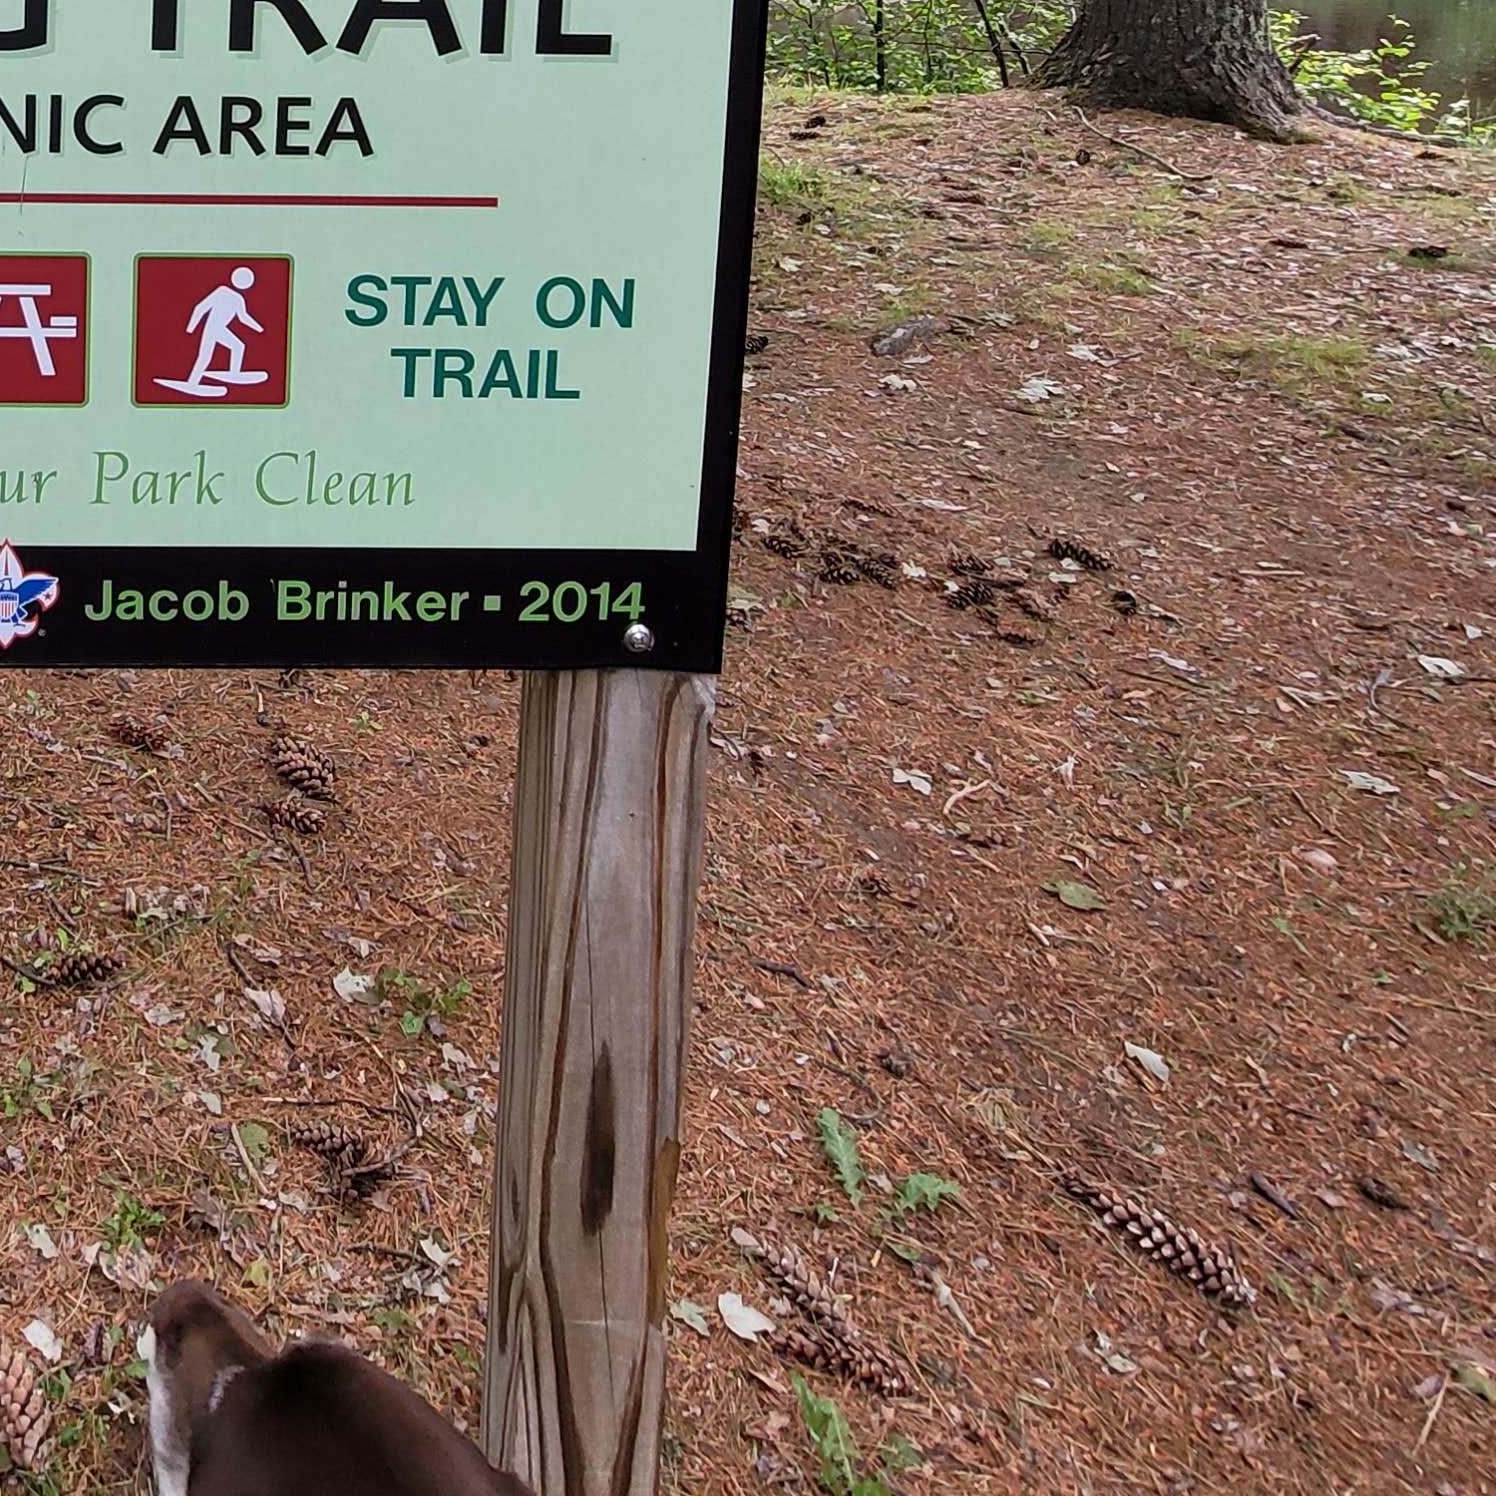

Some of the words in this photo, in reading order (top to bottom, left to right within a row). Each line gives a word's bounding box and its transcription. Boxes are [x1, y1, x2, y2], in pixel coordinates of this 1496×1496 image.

[152, 95, 375, 158] AREA
[344, 273, 507, 328] STAY
[535, 276, 636, 329] ON
[389, 347, 581, 400] TRAIL
[89, 448, 227, 508] Park
[253, 448, 417, 507] Clean
[84, 579, 250, 621] Jacob
[277, 580, 470, 622] Brinker
[518, 580, 646, 623] 2014
